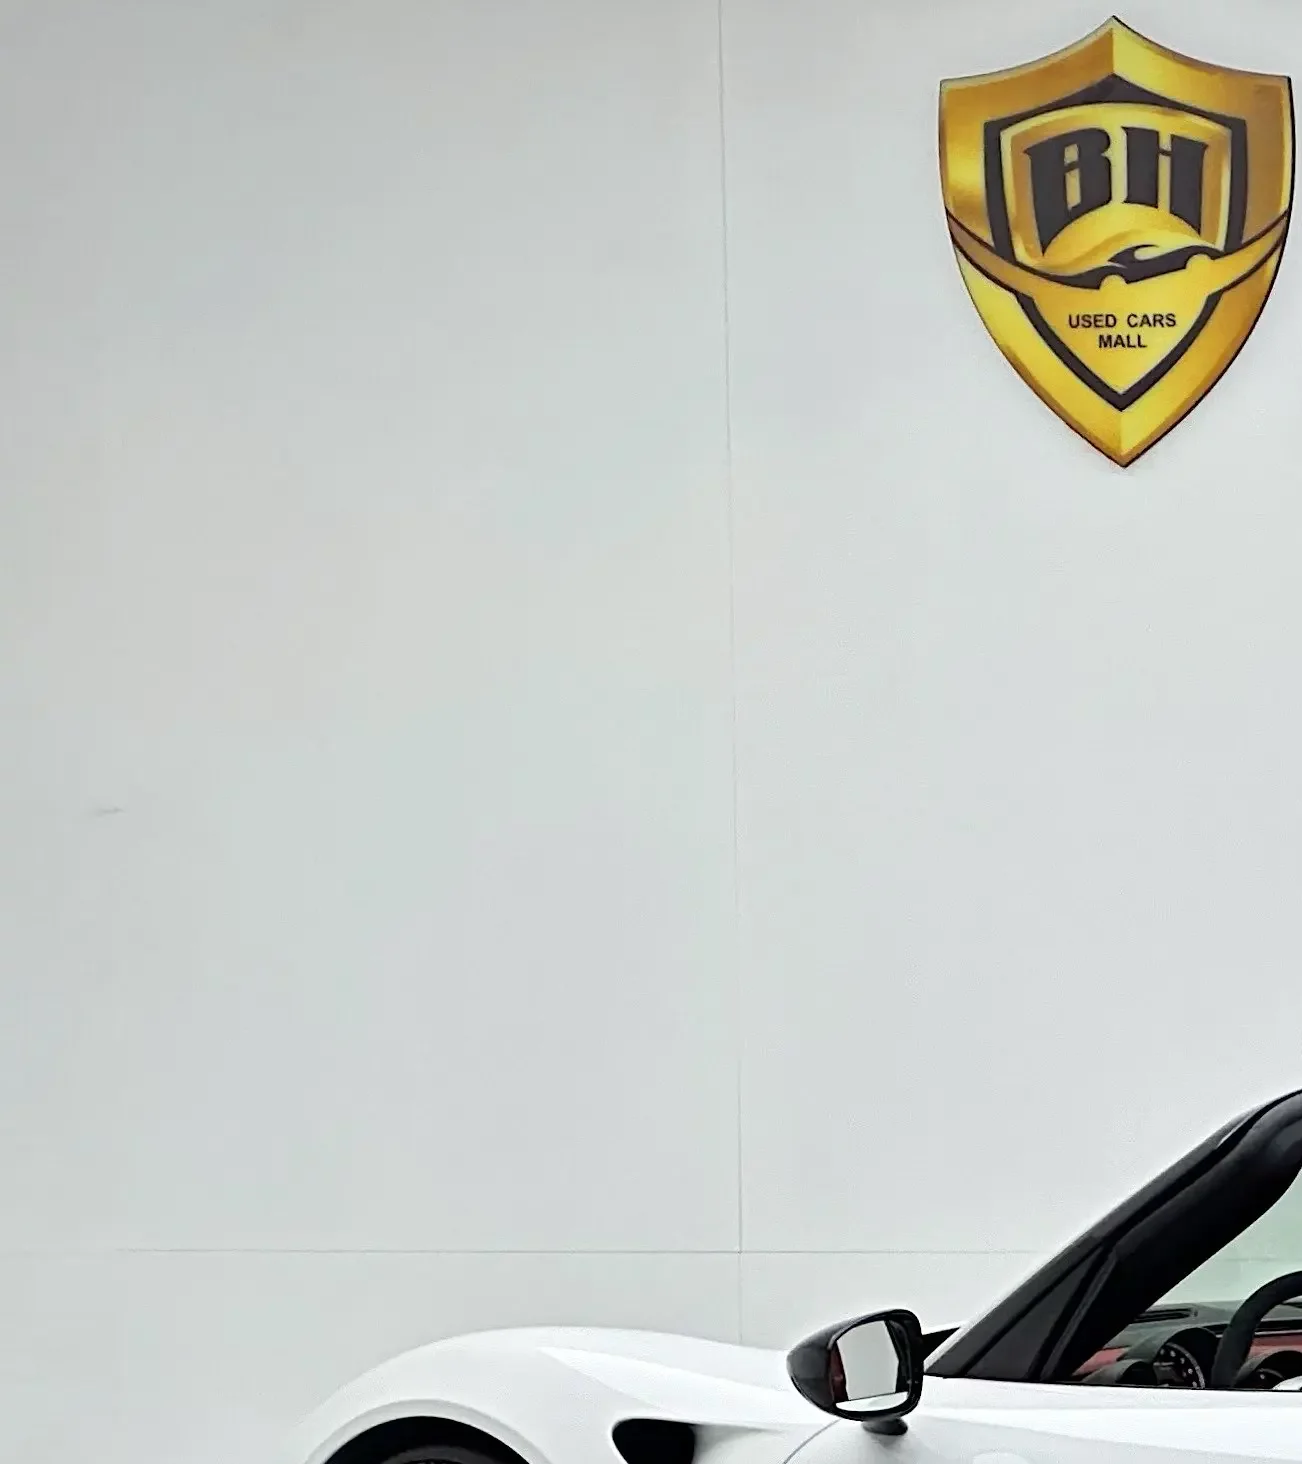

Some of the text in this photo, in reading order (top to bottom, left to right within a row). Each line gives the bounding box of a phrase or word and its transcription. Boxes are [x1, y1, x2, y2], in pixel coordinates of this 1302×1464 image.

[1024, 126, 1209, 256] BH
[1069, 312, 1176, 329] USED CARS
[1099, 333, 1147, 348] MALL
